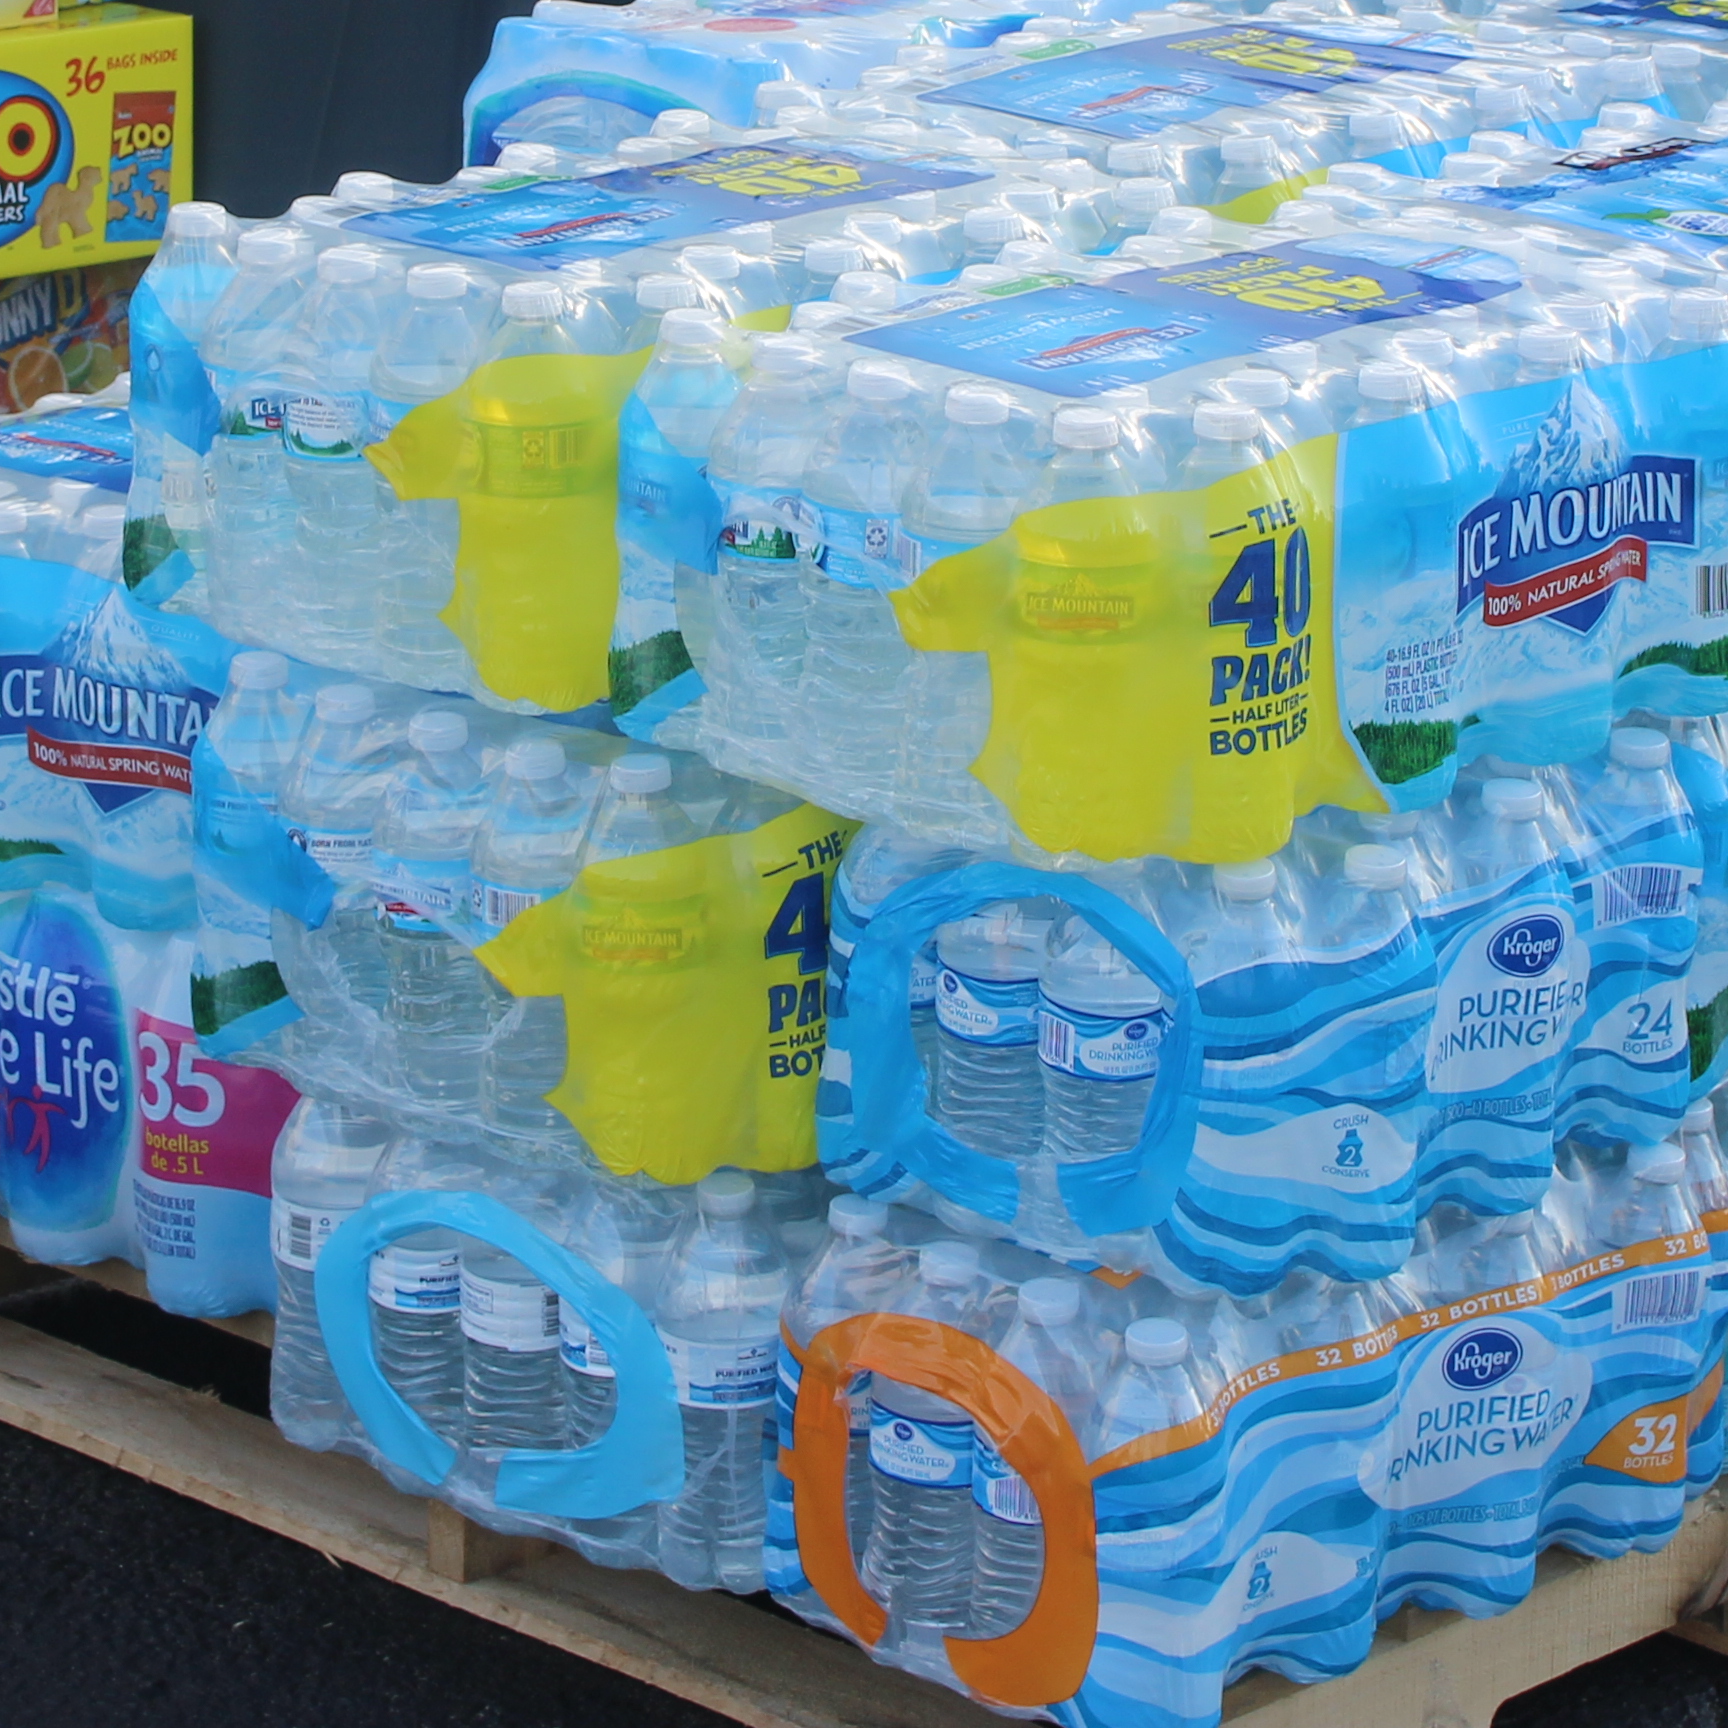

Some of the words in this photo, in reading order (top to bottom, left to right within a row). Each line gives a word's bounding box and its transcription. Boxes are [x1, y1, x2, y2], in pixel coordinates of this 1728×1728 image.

[64, 56, 106, 98] 36
[107, 56, 137, 71] BAGS
[139, 49, 178, 68] INSIDE
[112, 122, 172, 160] ZOO
[1236, 275, 1388, 313] 40
[1157, 321, 1203, 342] ICE
[1018, 332, 1159, 371] MOUNTAIN
[1501, 420, 1530, 437] PURE
[1246, 498, 1297, 536] THE
[1462, 507, 1500, 589] ICE
[1508, 472, 1683, 560] MOUNTAIN
[1208, 525, 1311, 647] 40
[1486, 591, 1522, 618] 100%
[1526, 568, 1596, 608] NATURAL
[1027, 595, 1062, 615] ICE
[1066, 595, 1131, 616] MOUNTAIN
[1209, 634, 1311, 708] PACK!
[1232, 704, 1272, 726] HALF
[1273, 693, 1301, 719] LITER
[1209, 711, 1307, 756] BOTTLES
[33, 741, 68, 768] 100%
[70, 754, 107, 772] NATURAL
[108, 758, 160, 776] SPRING
[332, 839, 356, 848] FROM
[798, 834, 844, 870] THE
[603, 926, 678, 948] MOUNTAIN
[1502, 927, 1558, 967] Kroger
[1626, 998, 1673, 1040] 24
[1088, 1048, 1142, 1061] DRINKING
[1111, 1037, 1159, 1051] PURIFIED
[1622, 1038, 1674, 1054] BOTTLES
[34, 1029, 121, 1130] Life
[138, 1029, 226, 1128] 35
[145, 1125, 211, 1155] botellas
[1332, 1115, 1371, 1133] CRUSH
[150, 1152, 168, 1172] de
[192, 1156, 203, 1175] L
[1321, 1164, 1372, 1180] CONSERVE
[1342, 1143, 1359, 1167] 2
[1664, 1237, 1687, 1259] 32
[419, 1275, 460, 1284] PURIFIED
[1558, 1252, 1625, 1293] BOTTLES
[1419, 1310, 1441, 1330] 32
[1448, 1285, 1537, 1322] BOTTLES
[1315, 1346, 1343, 1368] 32
[1452, 1343, 1514, 1381] Kroger
[1415, 1388, 1552, 1440] PURIFIED
[883, 1434, 924, 1454] PURIFIED
[1627, 1415, 1677, 1456] 32
[908, 1453, 945, 1468] WATER
[1622, 1453, 1674, 1470] BOTTLES
[1252, 1576, 1268, 1596] 2
